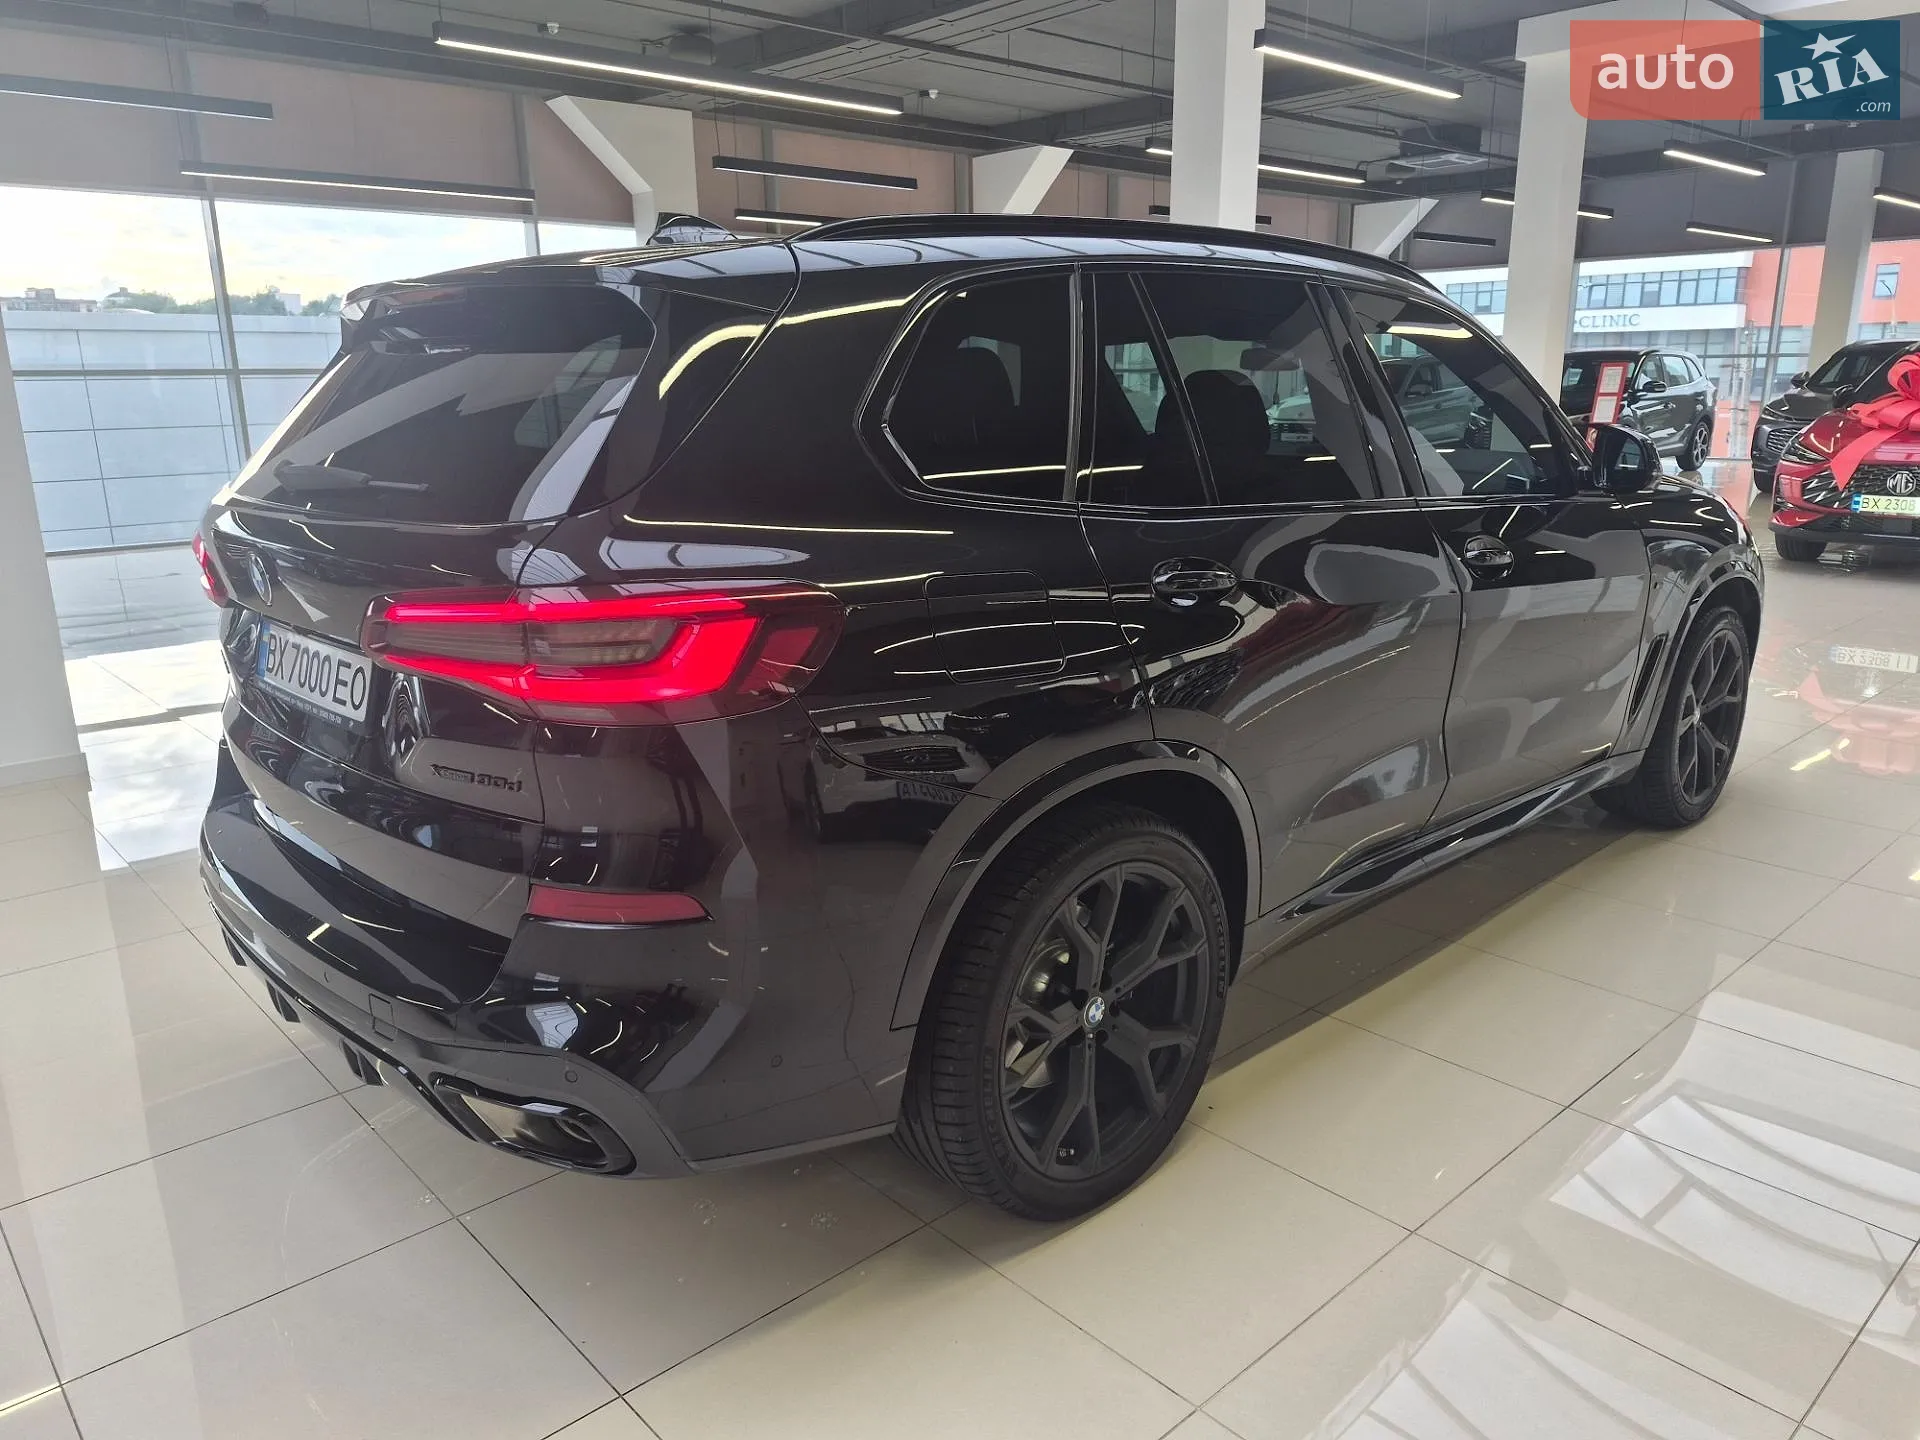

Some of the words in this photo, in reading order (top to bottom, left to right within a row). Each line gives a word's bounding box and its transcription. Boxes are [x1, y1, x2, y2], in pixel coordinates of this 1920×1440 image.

[1578, 313, 1641, 329] CLINIC
[1889, 472, 1914, 494] MG
[1861, 497, 1881, 510] BX
[266, 633, 289, 680] BX
[288, 642, 332, 698] 7000
[332, 658, 367, 711] EO
